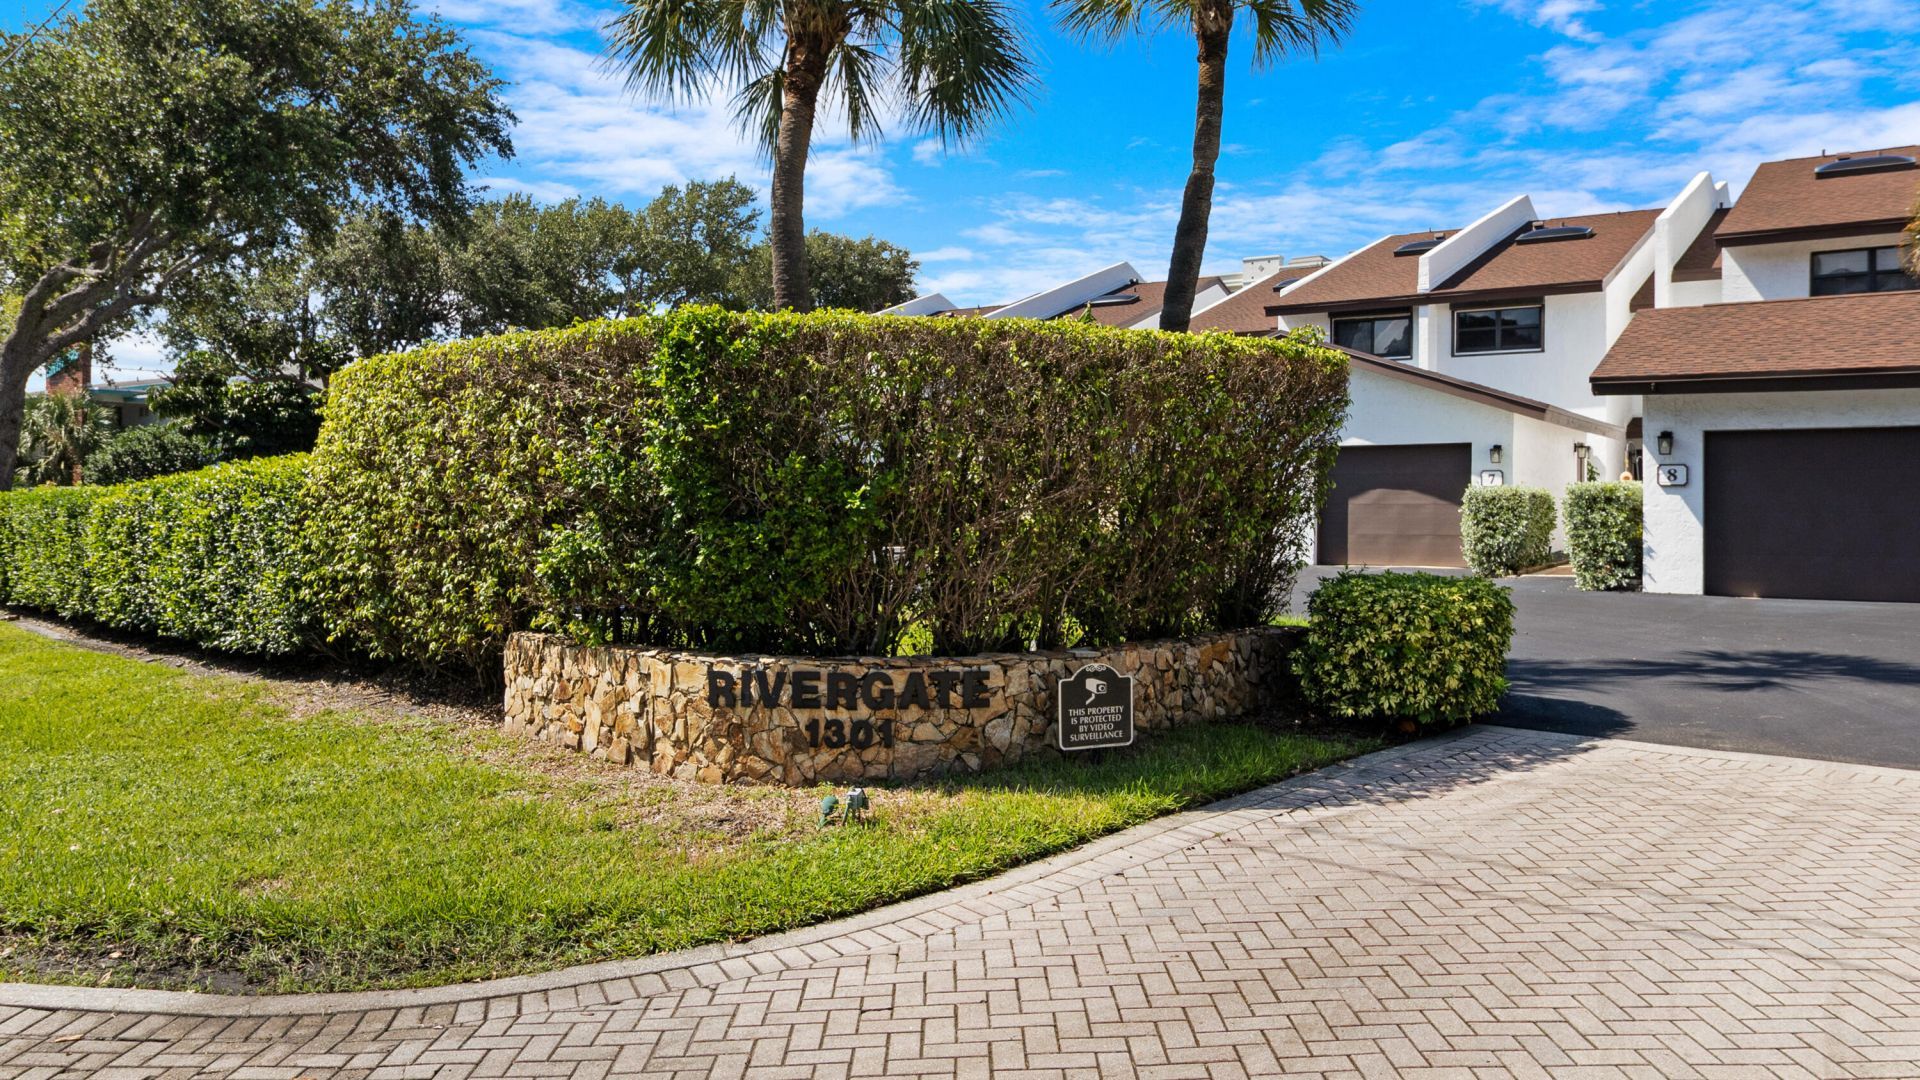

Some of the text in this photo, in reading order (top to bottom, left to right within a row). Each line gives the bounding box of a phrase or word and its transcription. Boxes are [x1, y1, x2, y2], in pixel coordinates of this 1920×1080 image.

[1487, 473, 1496, 484] 7
[1667, 468, 1678, 482] 8
[707, 670, 990, 711] RIVERGATE
[1068, 705, 1124, 716] THIS PROPERTY
[1071, 714, 1122, 725] IS PROTECTED
[1079, 722, 1114, 733] BY VIDEO
[804, 718, 893, 749] 1301
[1070, 730, 1123, 741] SURVEILLANCE
